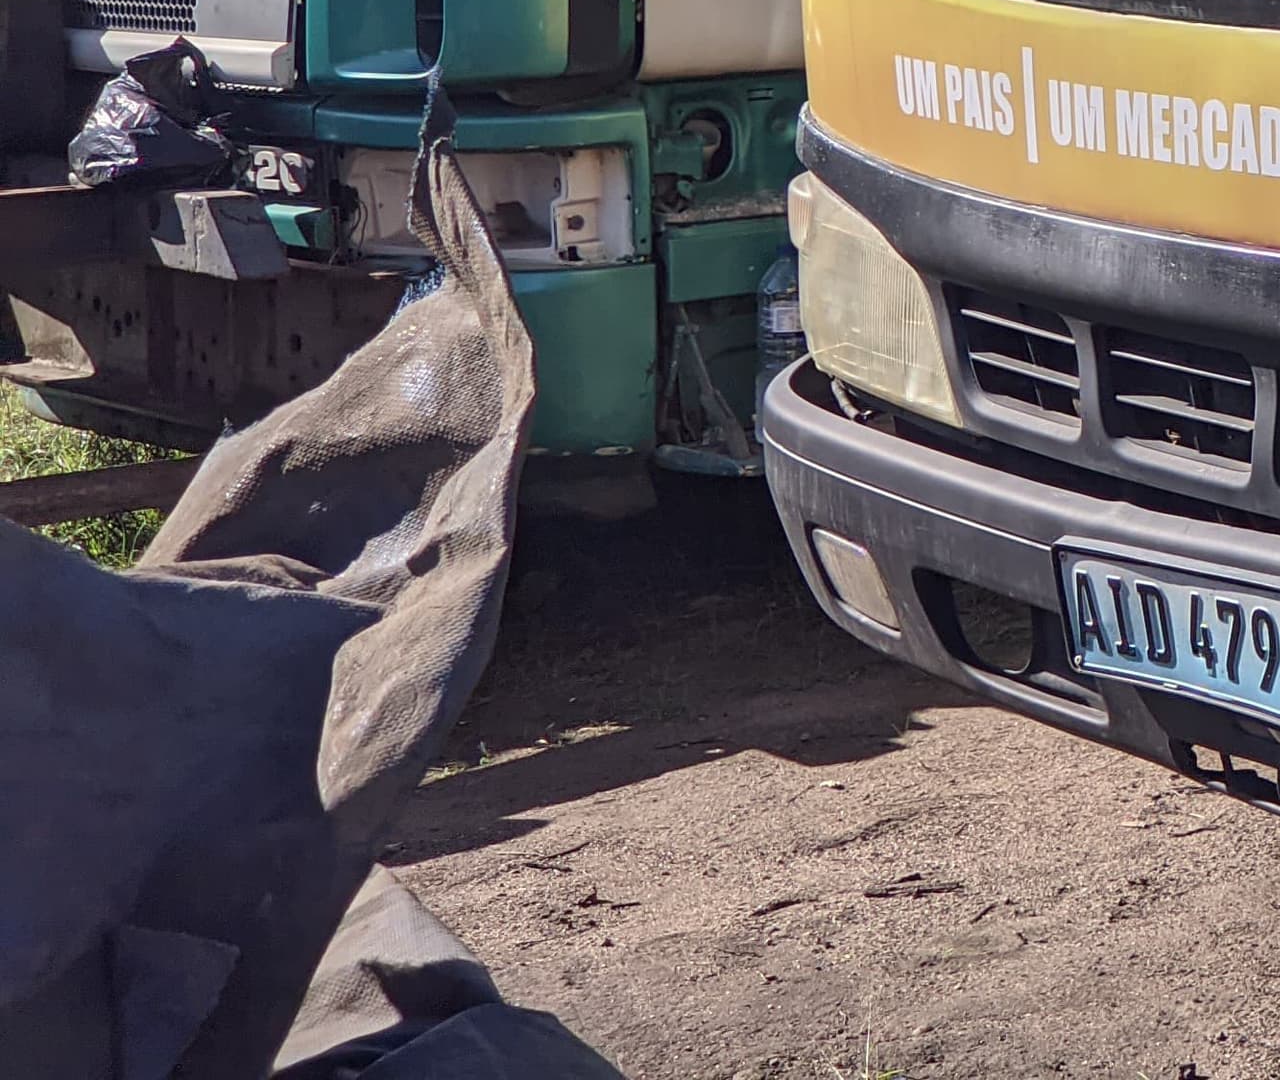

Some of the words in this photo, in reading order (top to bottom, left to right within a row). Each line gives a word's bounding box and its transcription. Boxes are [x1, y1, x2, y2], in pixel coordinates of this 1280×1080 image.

[895, 54, 940, 121] UM
[945, 63, 1014, 137] PAIS
[1049, 78, 1106, 153] UM
[1075, 569, 1178, 667] AID
[1190, 590, 1280, 694] 479
